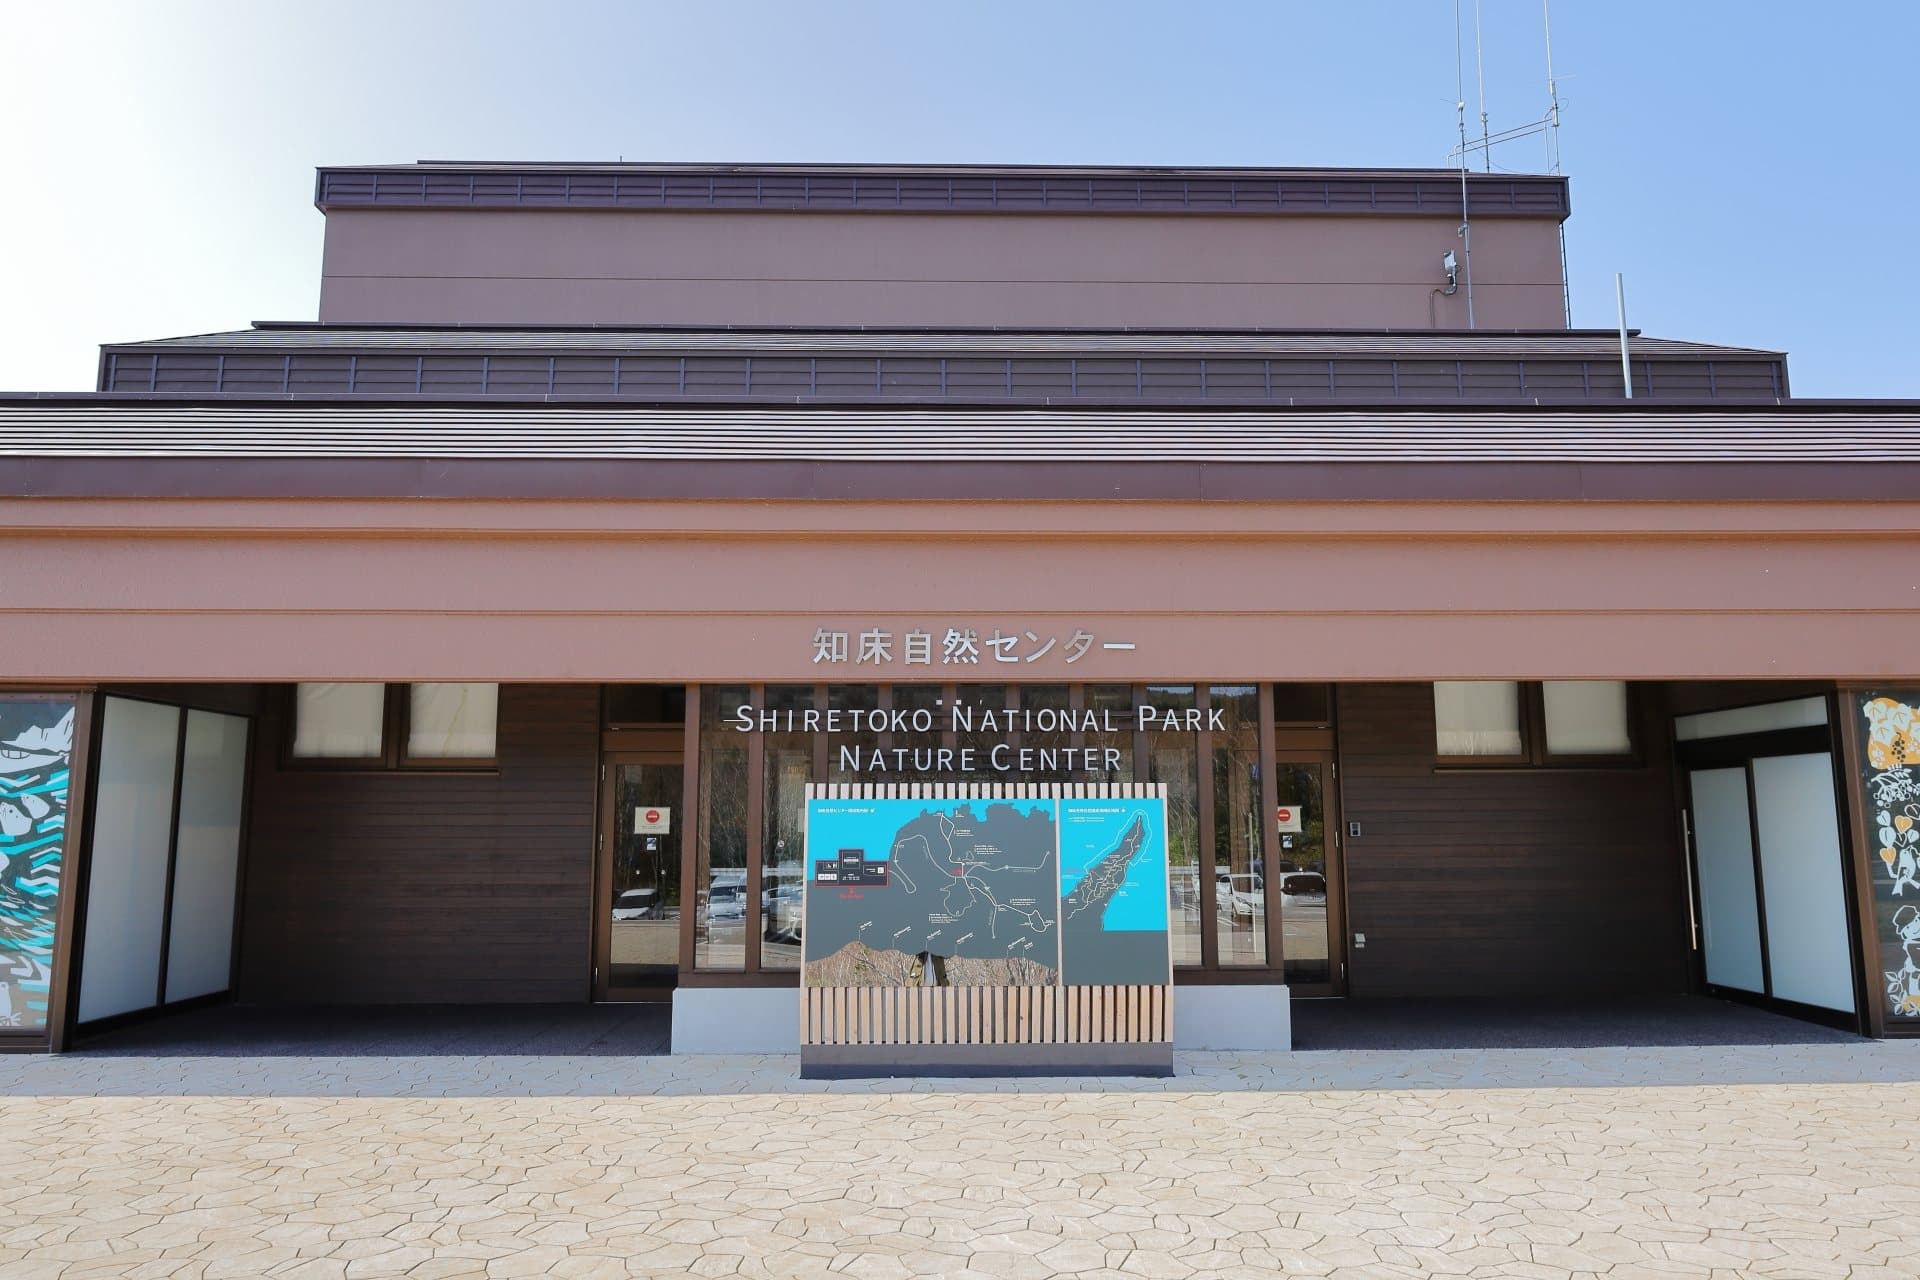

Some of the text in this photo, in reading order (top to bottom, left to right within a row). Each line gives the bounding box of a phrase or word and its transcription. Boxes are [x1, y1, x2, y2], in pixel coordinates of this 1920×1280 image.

[813, 627, 1136, 665] 知床自然センター
[736, 705, 1225, 732] SHIRETOKO NATIONAL PARK
[840, 744, 1122, 771] NATURE CENTER
